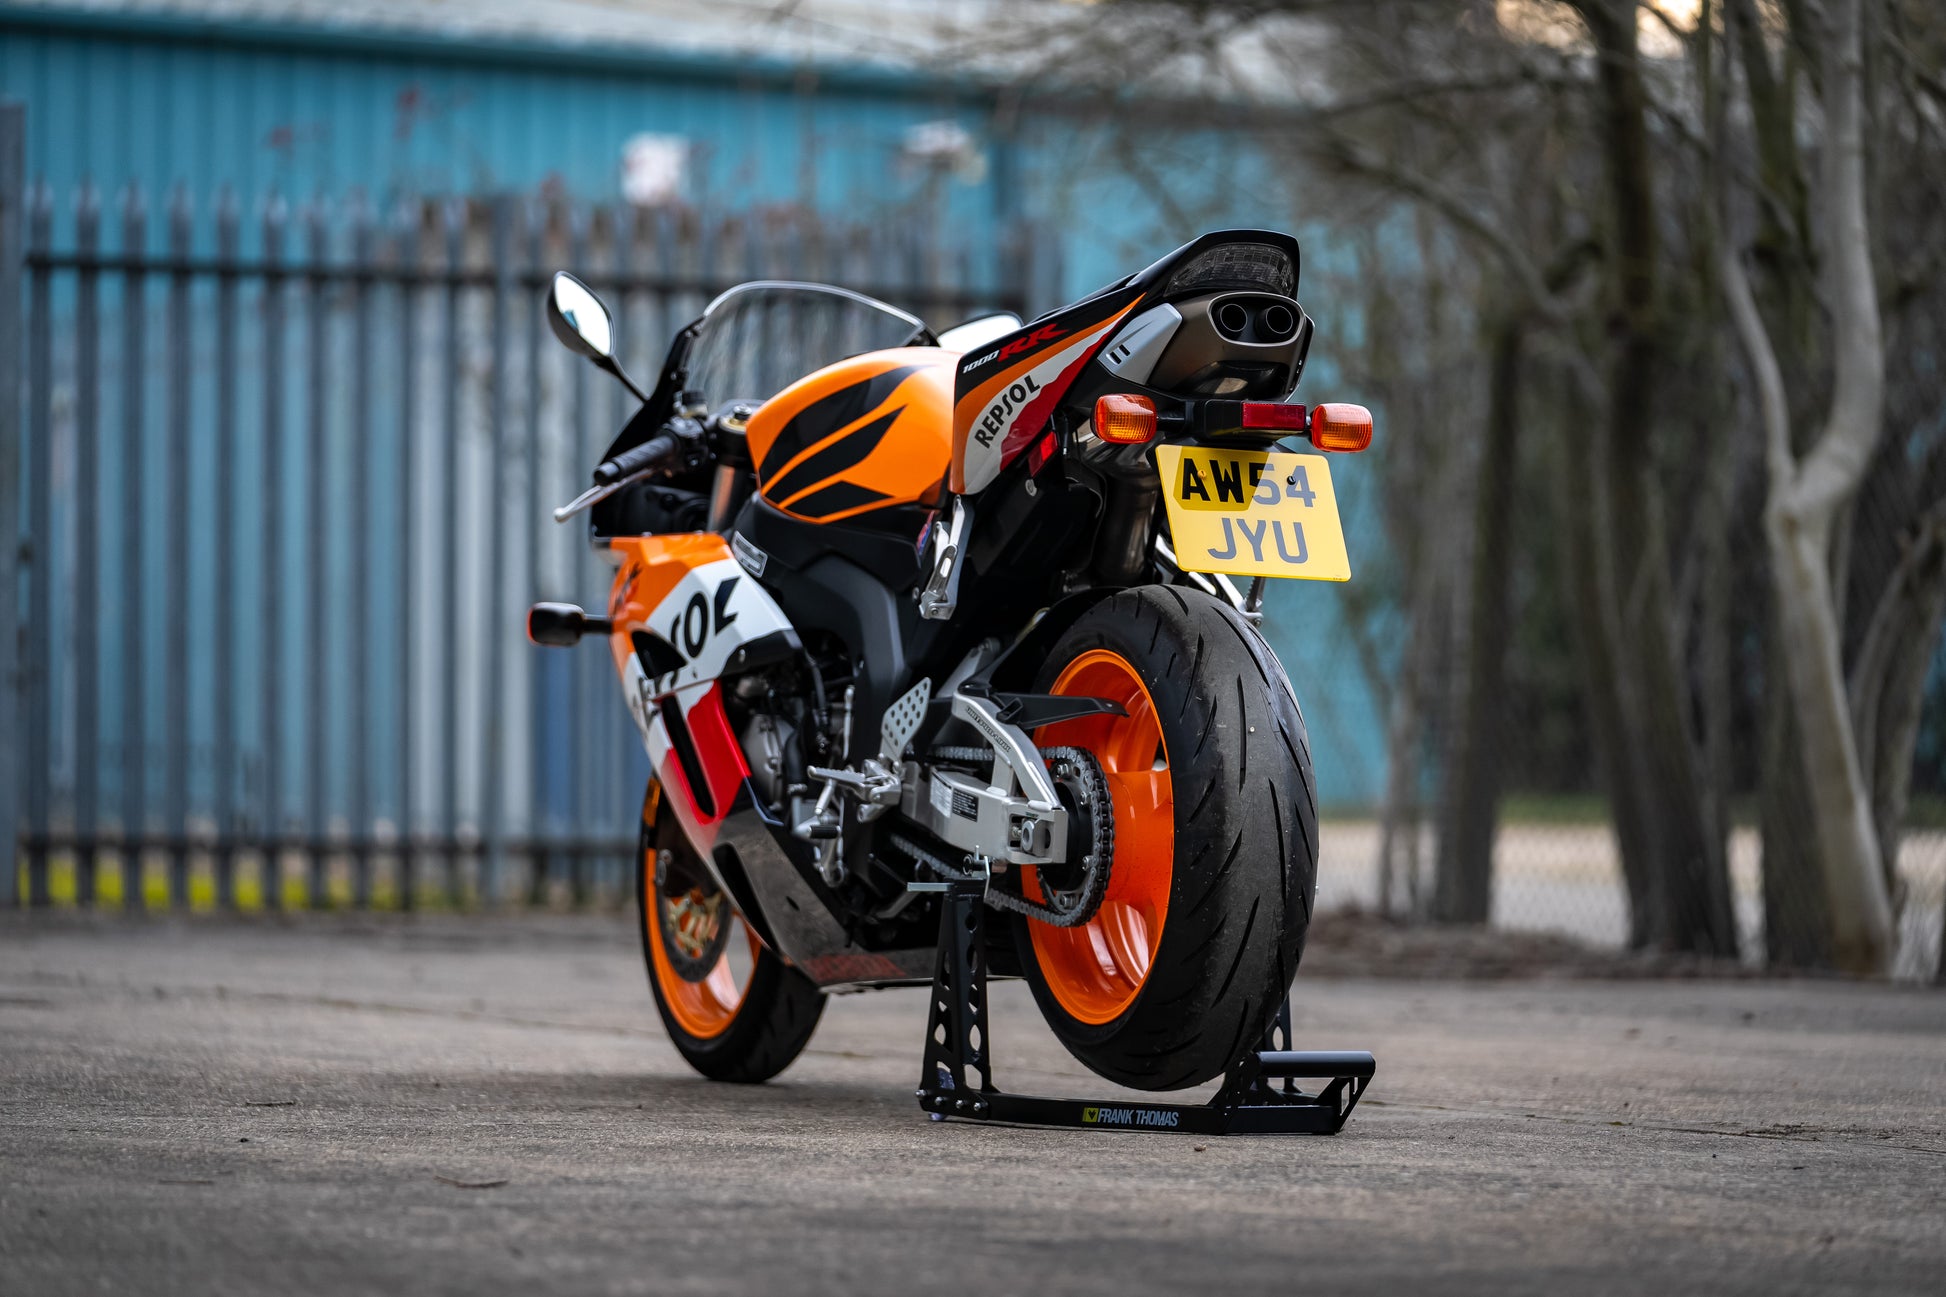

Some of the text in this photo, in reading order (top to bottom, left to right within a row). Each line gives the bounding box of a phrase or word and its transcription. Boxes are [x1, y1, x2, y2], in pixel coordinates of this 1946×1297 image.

[974, 375, 1041, 449] REPSOL
[1181, 457, 1317, 508] AW54
[1207, 517, 1309, 564] JYU
[1097, 1107, 1179, 1127] FRANK THOMAS
